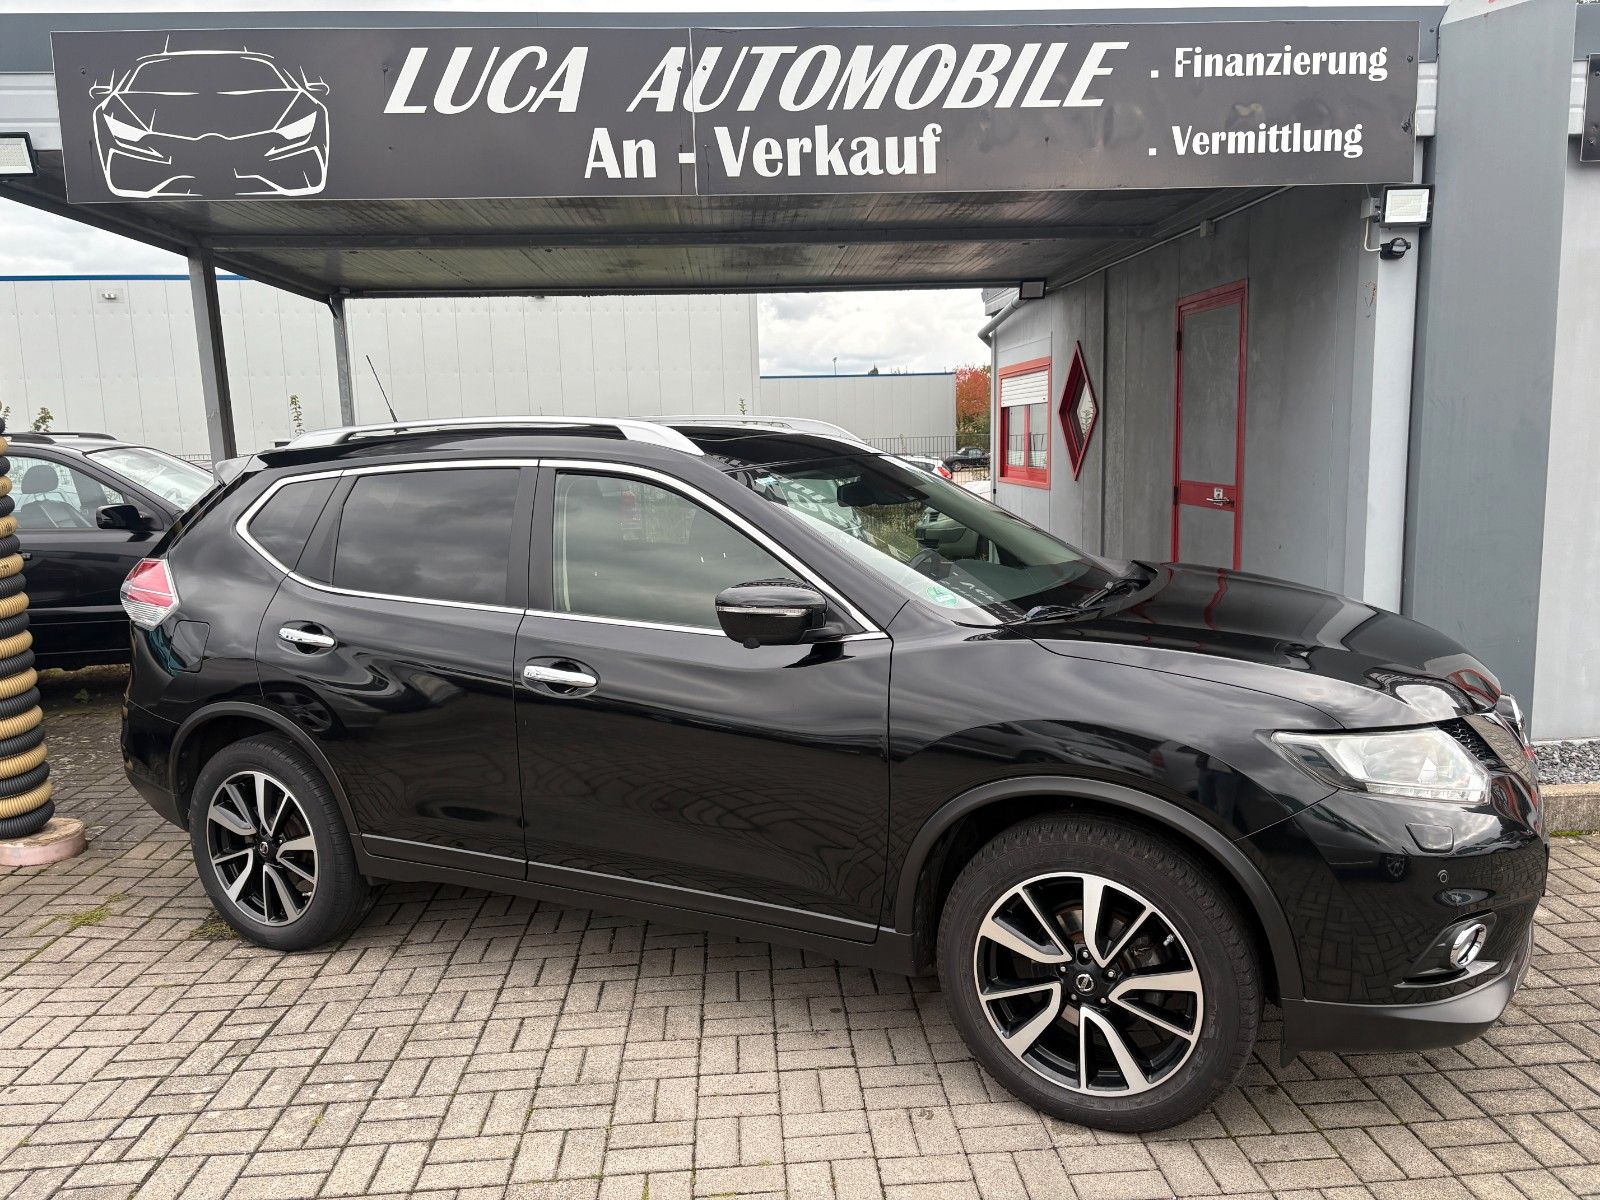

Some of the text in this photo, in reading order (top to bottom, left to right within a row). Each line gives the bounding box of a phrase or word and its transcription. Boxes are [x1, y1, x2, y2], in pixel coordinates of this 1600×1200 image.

[384, 41, 1129, 114] LUCA AUTOMOBILE
[1174, 45, 1389, 82] Finanzierung
[584, 127, 657, 179] An
[713, 122, 943, 179] Verkauf
[1171, 122, 1364, 159] Vermittlung
